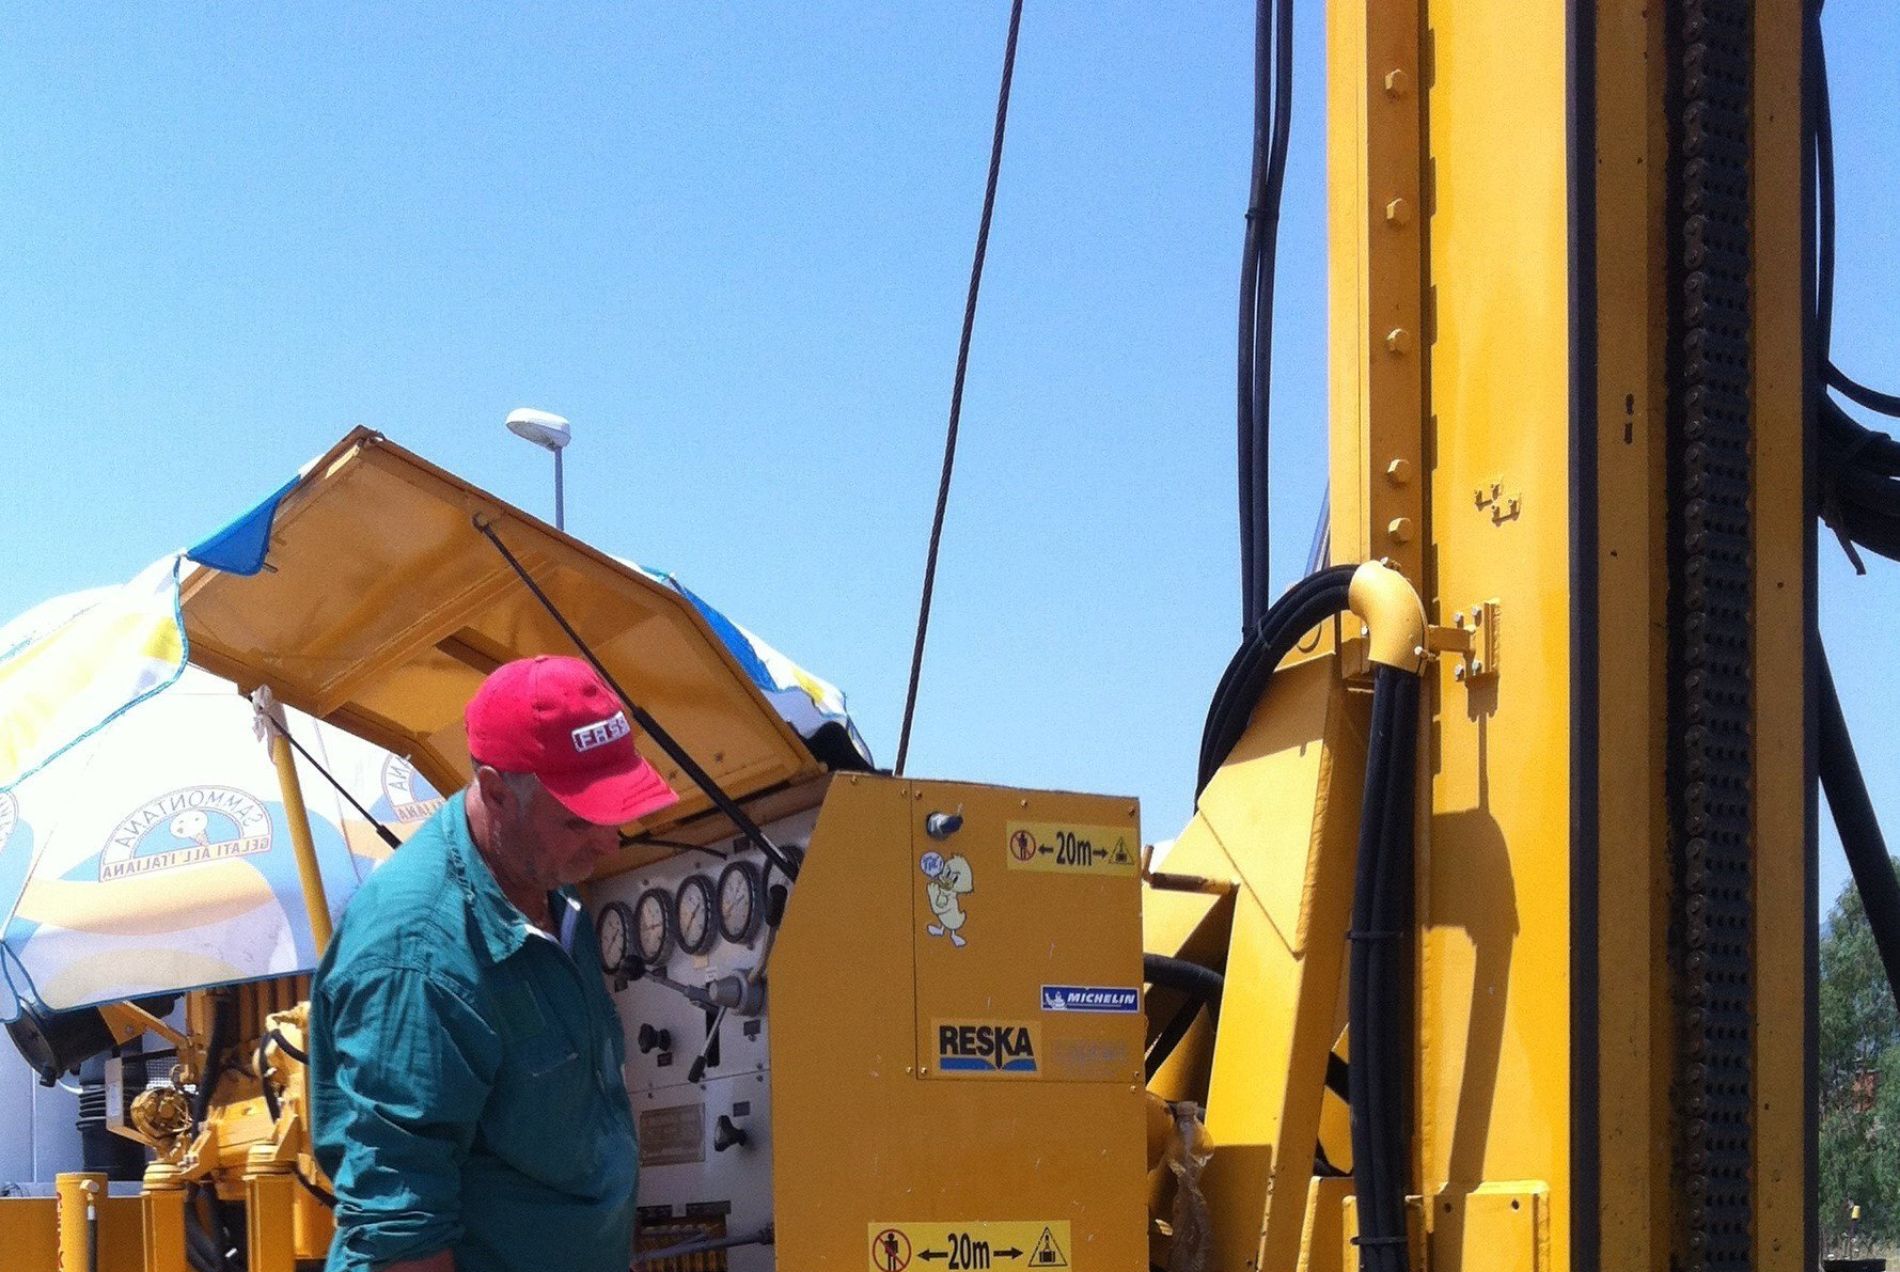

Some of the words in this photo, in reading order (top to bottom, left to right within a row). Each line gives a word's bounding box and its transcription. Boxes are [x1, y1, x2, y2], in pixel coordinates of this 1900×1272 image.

[1055, 831, 1092, 866] 20m
[1067, 992, 1135, 1005] MICHELIN
[939, 1025, 1035, 1070] RESKA
[947, 1232, 990, 1270] 20m
